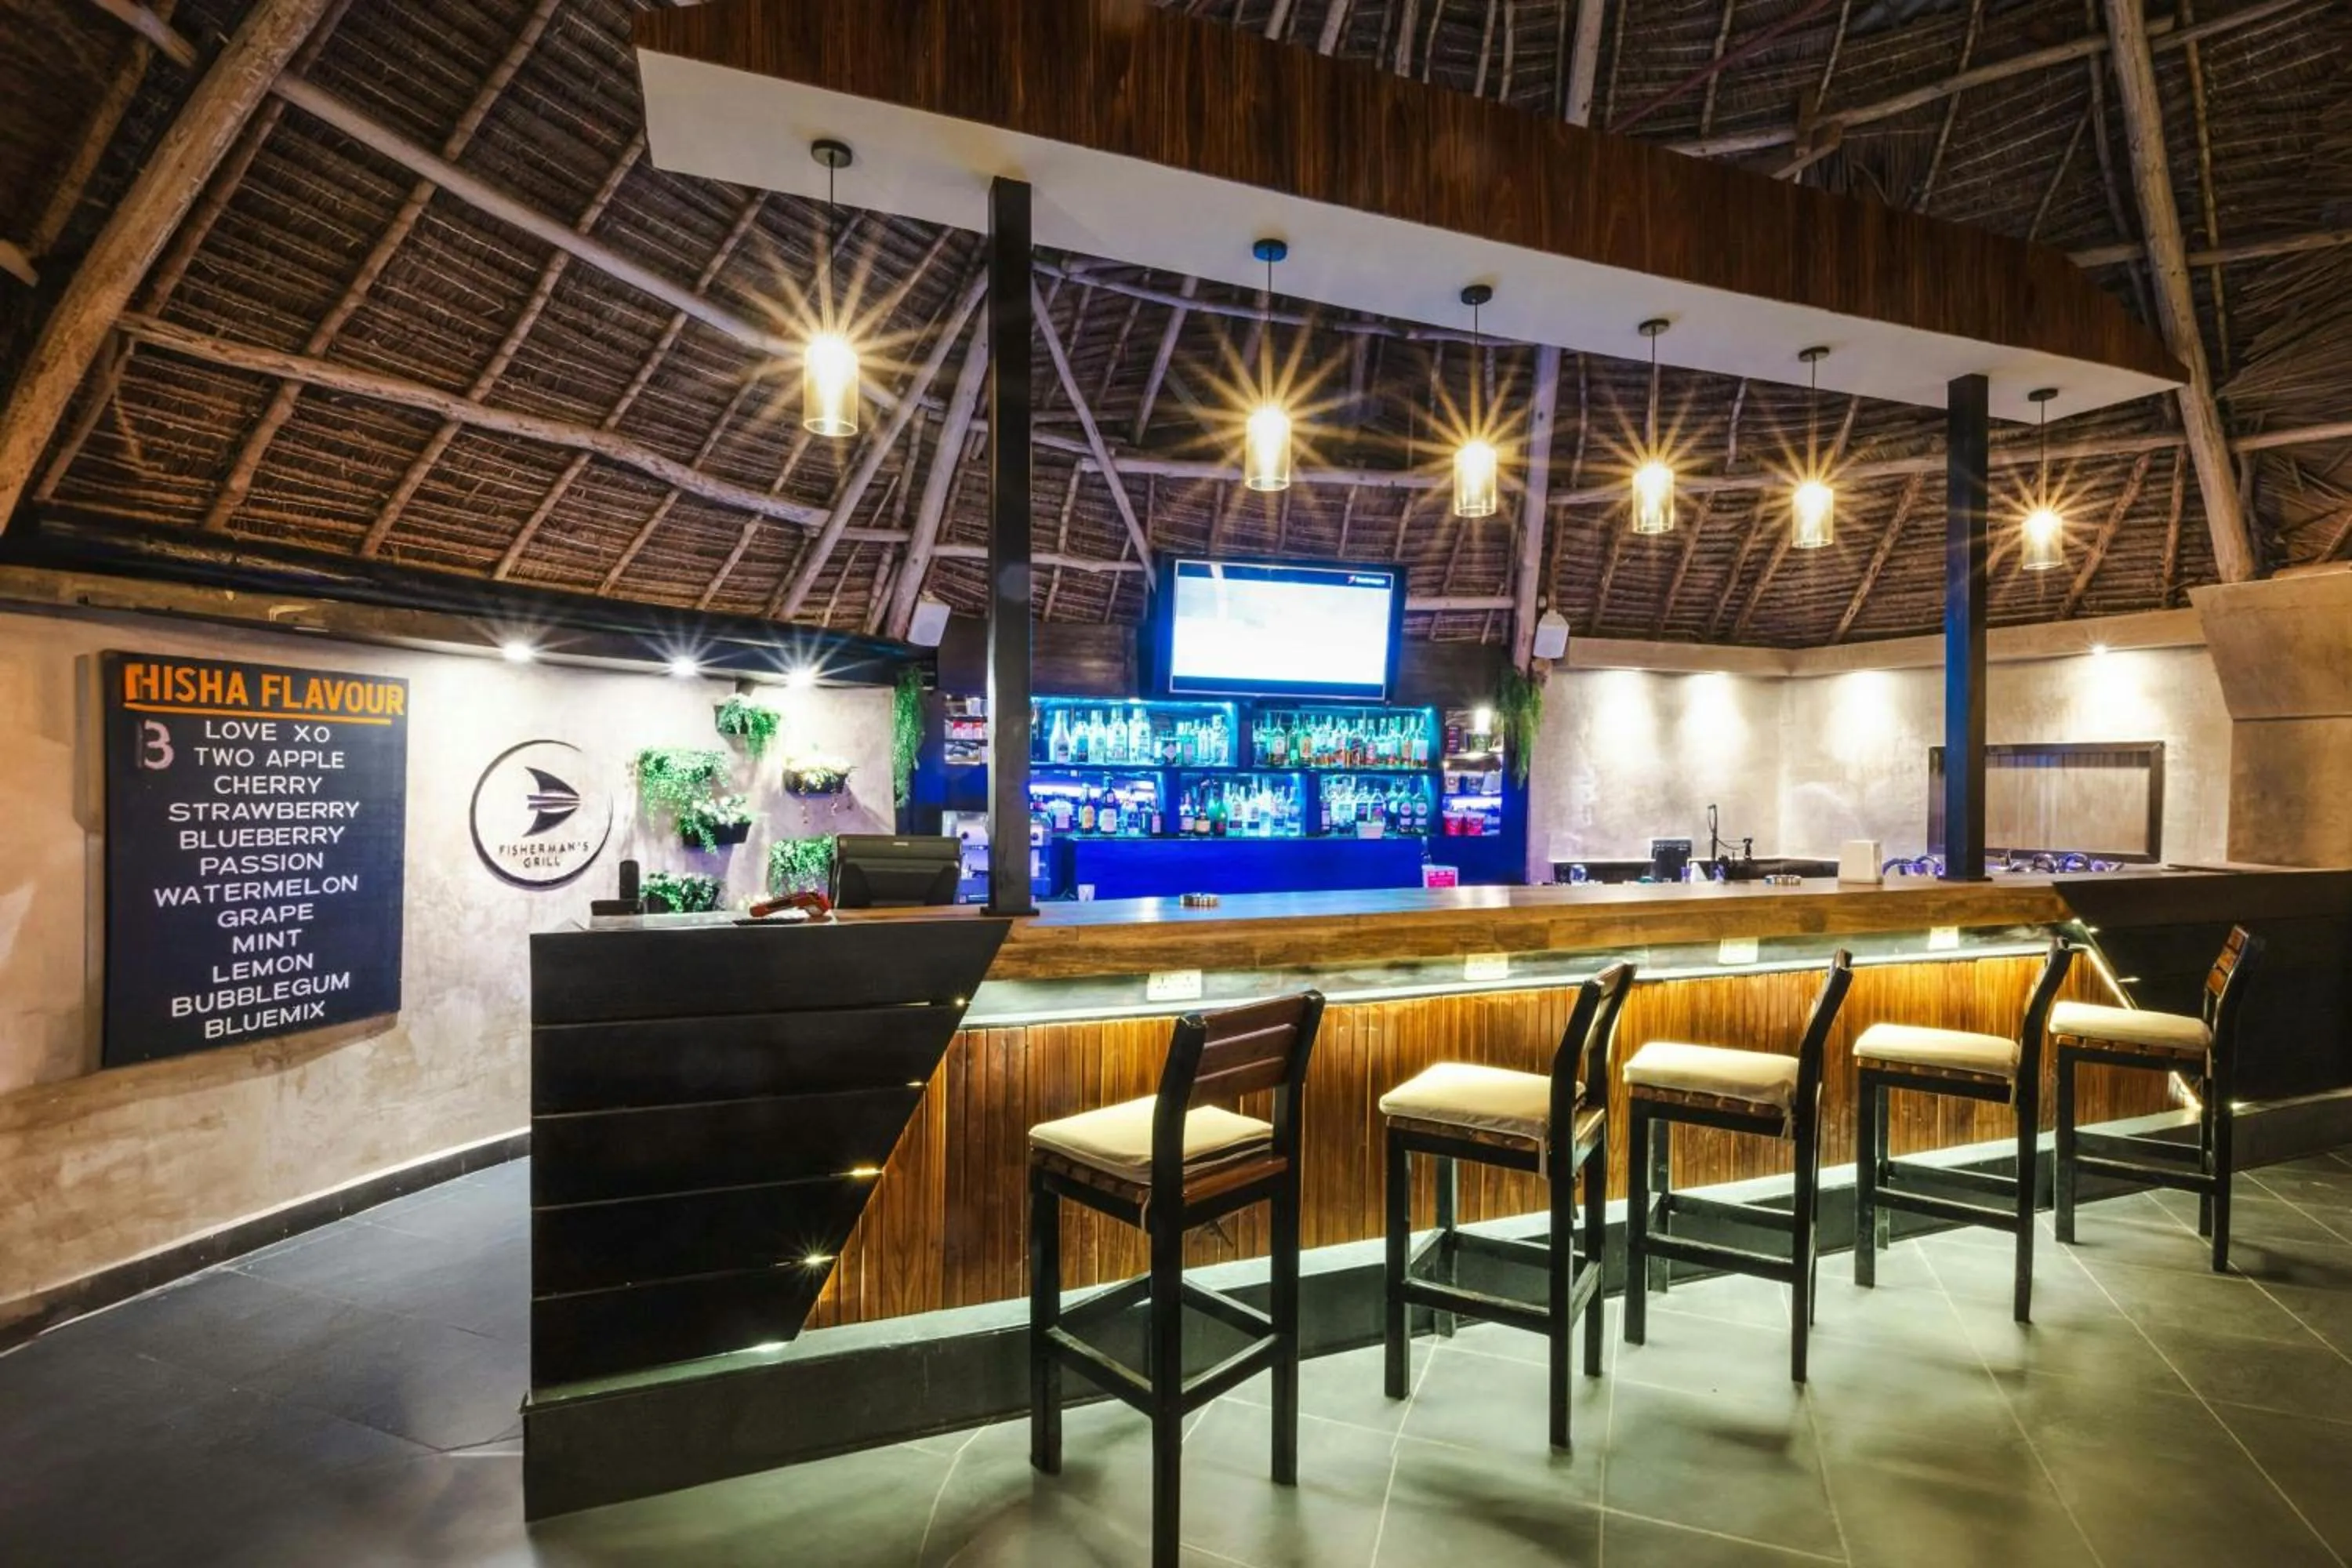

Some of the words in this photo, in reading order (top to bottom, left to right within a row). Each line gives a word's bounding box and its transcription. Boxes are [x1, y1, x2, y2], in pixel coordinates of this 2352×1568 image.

[261, 674, 405, 715] FLAVOUR
[205, 720, 278, 742] LOVE
[293, 724, 331, 743] XO
[194, 747, 255, 768] TWO
[265, 750, 346, 769] APPLE
[213, 775, 323, 794] CHERRY
[168, 800, 361, 822] STRAWBERRY
[180, 826, 346, 850] BLUEBERRY
[499, 841, 589, 855] FISHERMAN'S
[200, 852, 324, 876] PASSION
[523, 857, 561, 868] GRILL
[154, 874, 359, 909] WATERMELON
[217, 902, 314, 928] GRAPE
[232, 928, 303, 954] MINT
[212, 953, 314, 984] LEMON
[171, 971, 350, 1018] BUBBLEGUM
[204, 1000, 326, 1040] BLUEMIX
